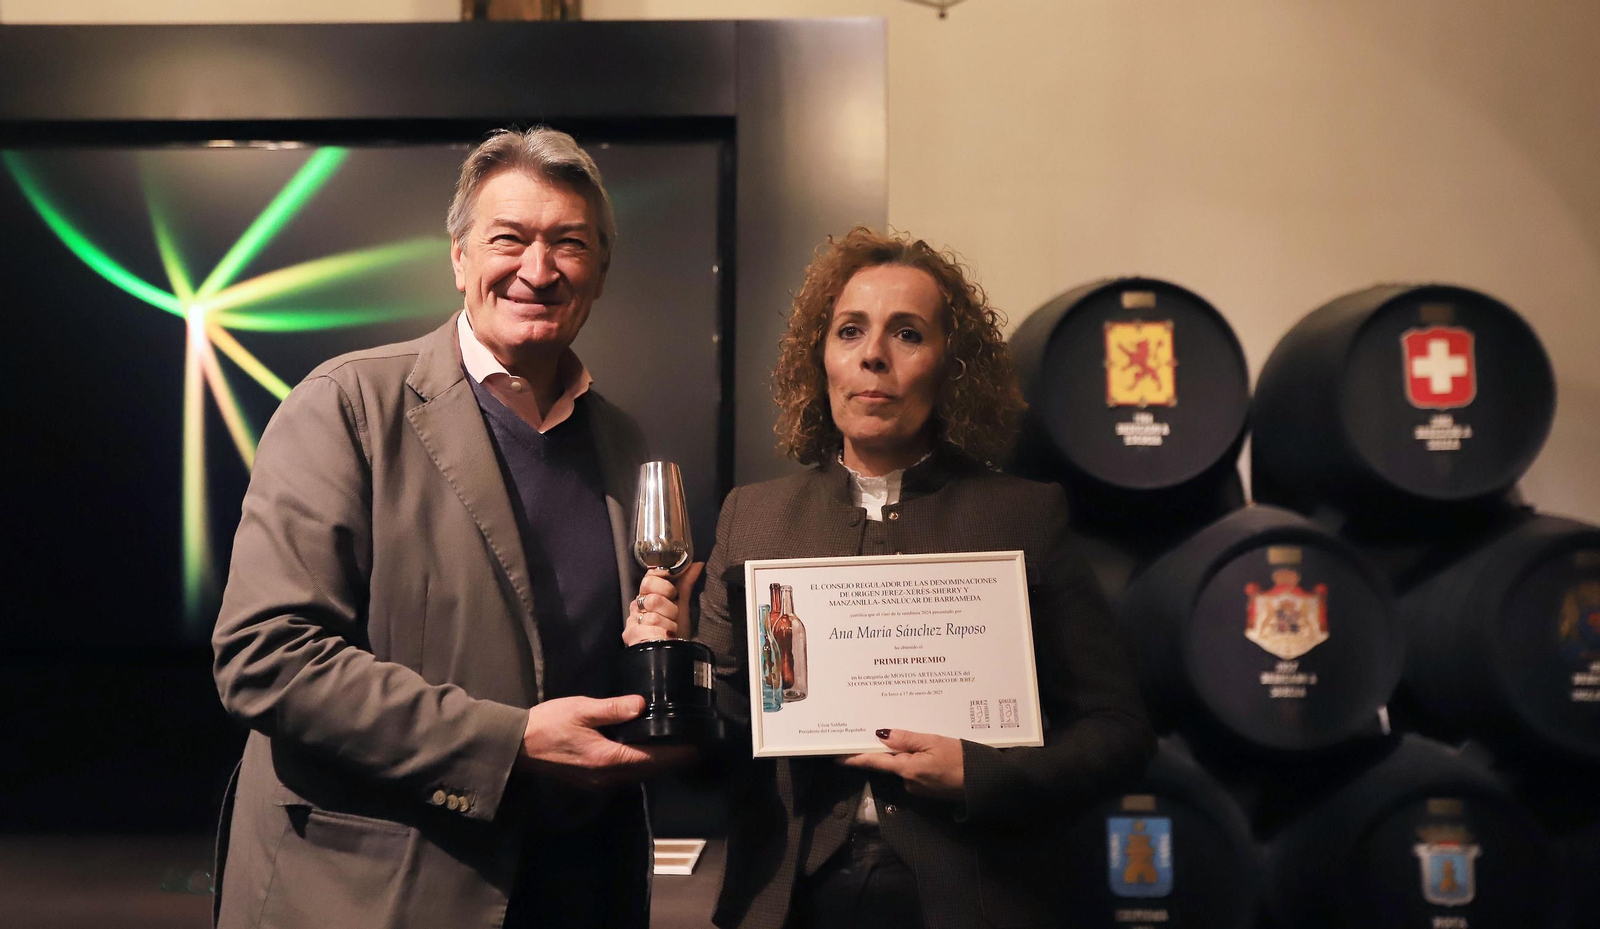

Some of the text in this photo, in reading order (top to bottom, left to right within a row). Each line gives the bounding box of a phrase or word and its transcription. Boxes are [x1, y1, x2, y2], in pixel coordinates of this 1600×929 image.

[855, 581, 901, 589] REGULADOR
[930, 577, 997, 585] DENOMINACIONES
[882, 597, 921, 605] SANLÚCAR
[934, 595, 981, 603] BARRAMEDA
[829, 622, 986, 640] Ana María Sánchez Raposo
[874, 656, 946, 665] PRIMER PREMIO
